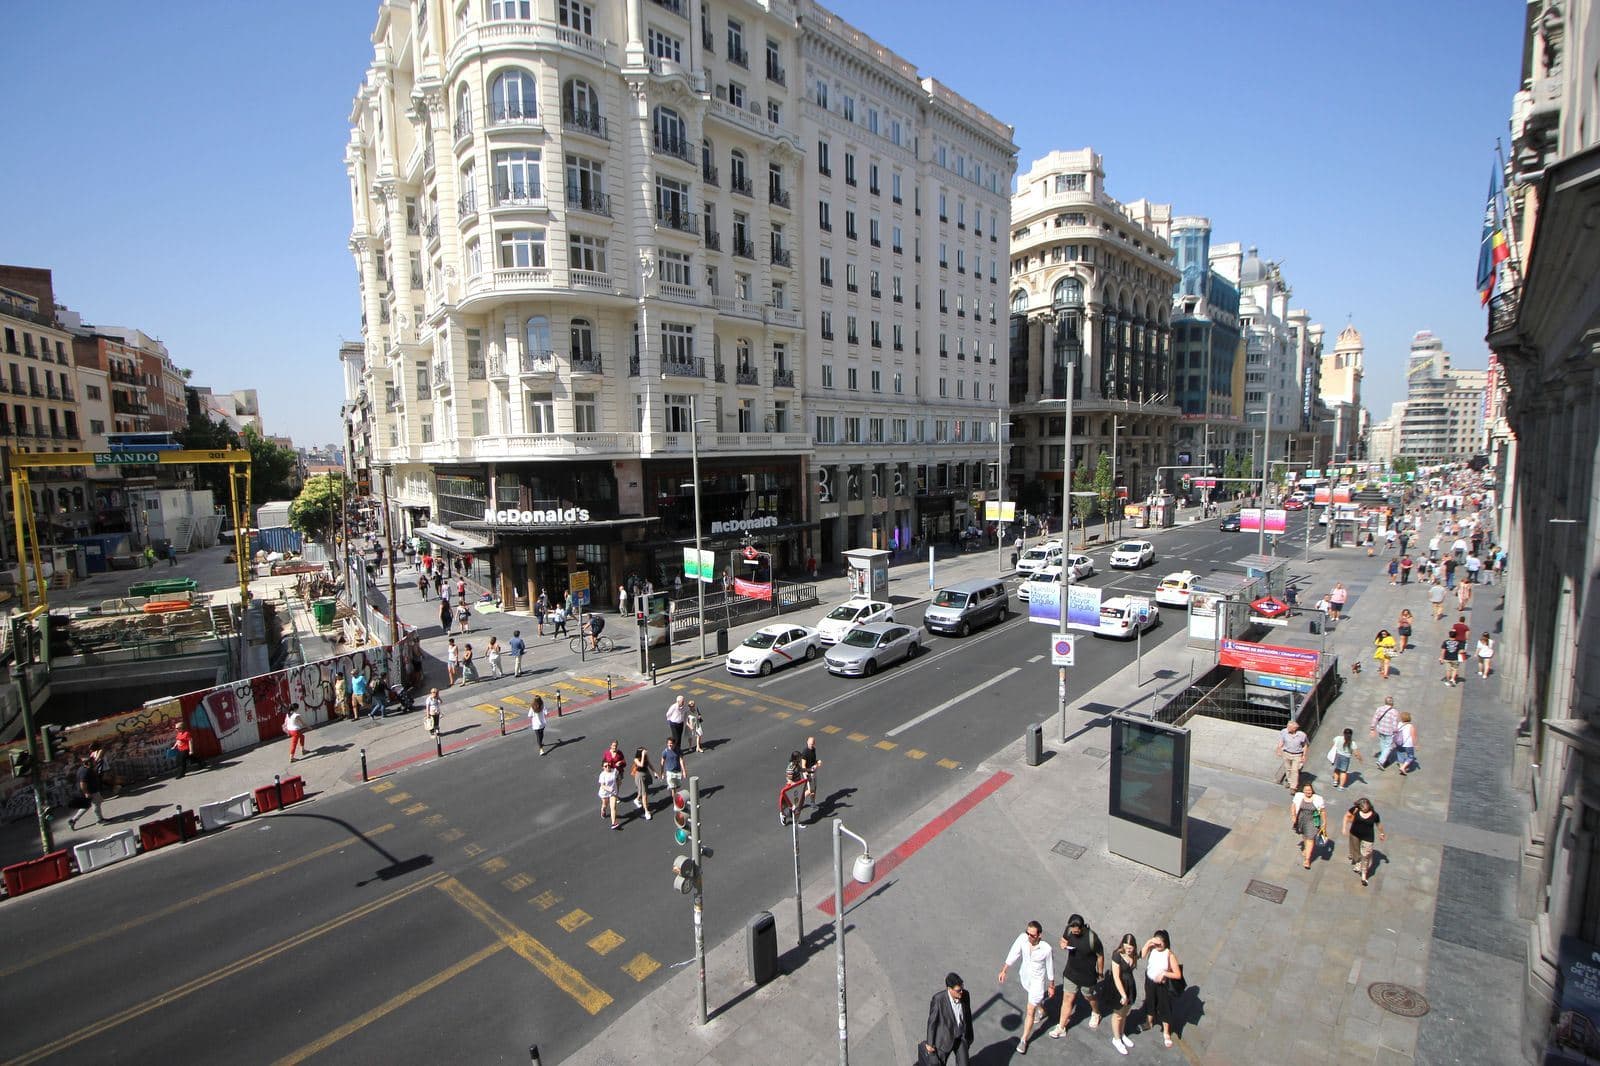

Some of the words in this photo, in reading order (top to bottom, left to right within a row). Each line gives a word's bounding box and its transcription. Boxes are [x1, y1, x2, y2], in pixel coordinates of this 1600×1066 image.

[102, 452, 158, 462] SANDO
[484, 508, 590, 524] McDonald's
[711, 516, 778, 533] McDonald's
[1031, 591, 1050, 600] Mayor
[1070, 596, 1090, 605] Mayor
[1031, 597, 1055, 606] Orgullo
[1071, 602, 1094, 612] Orgullo
